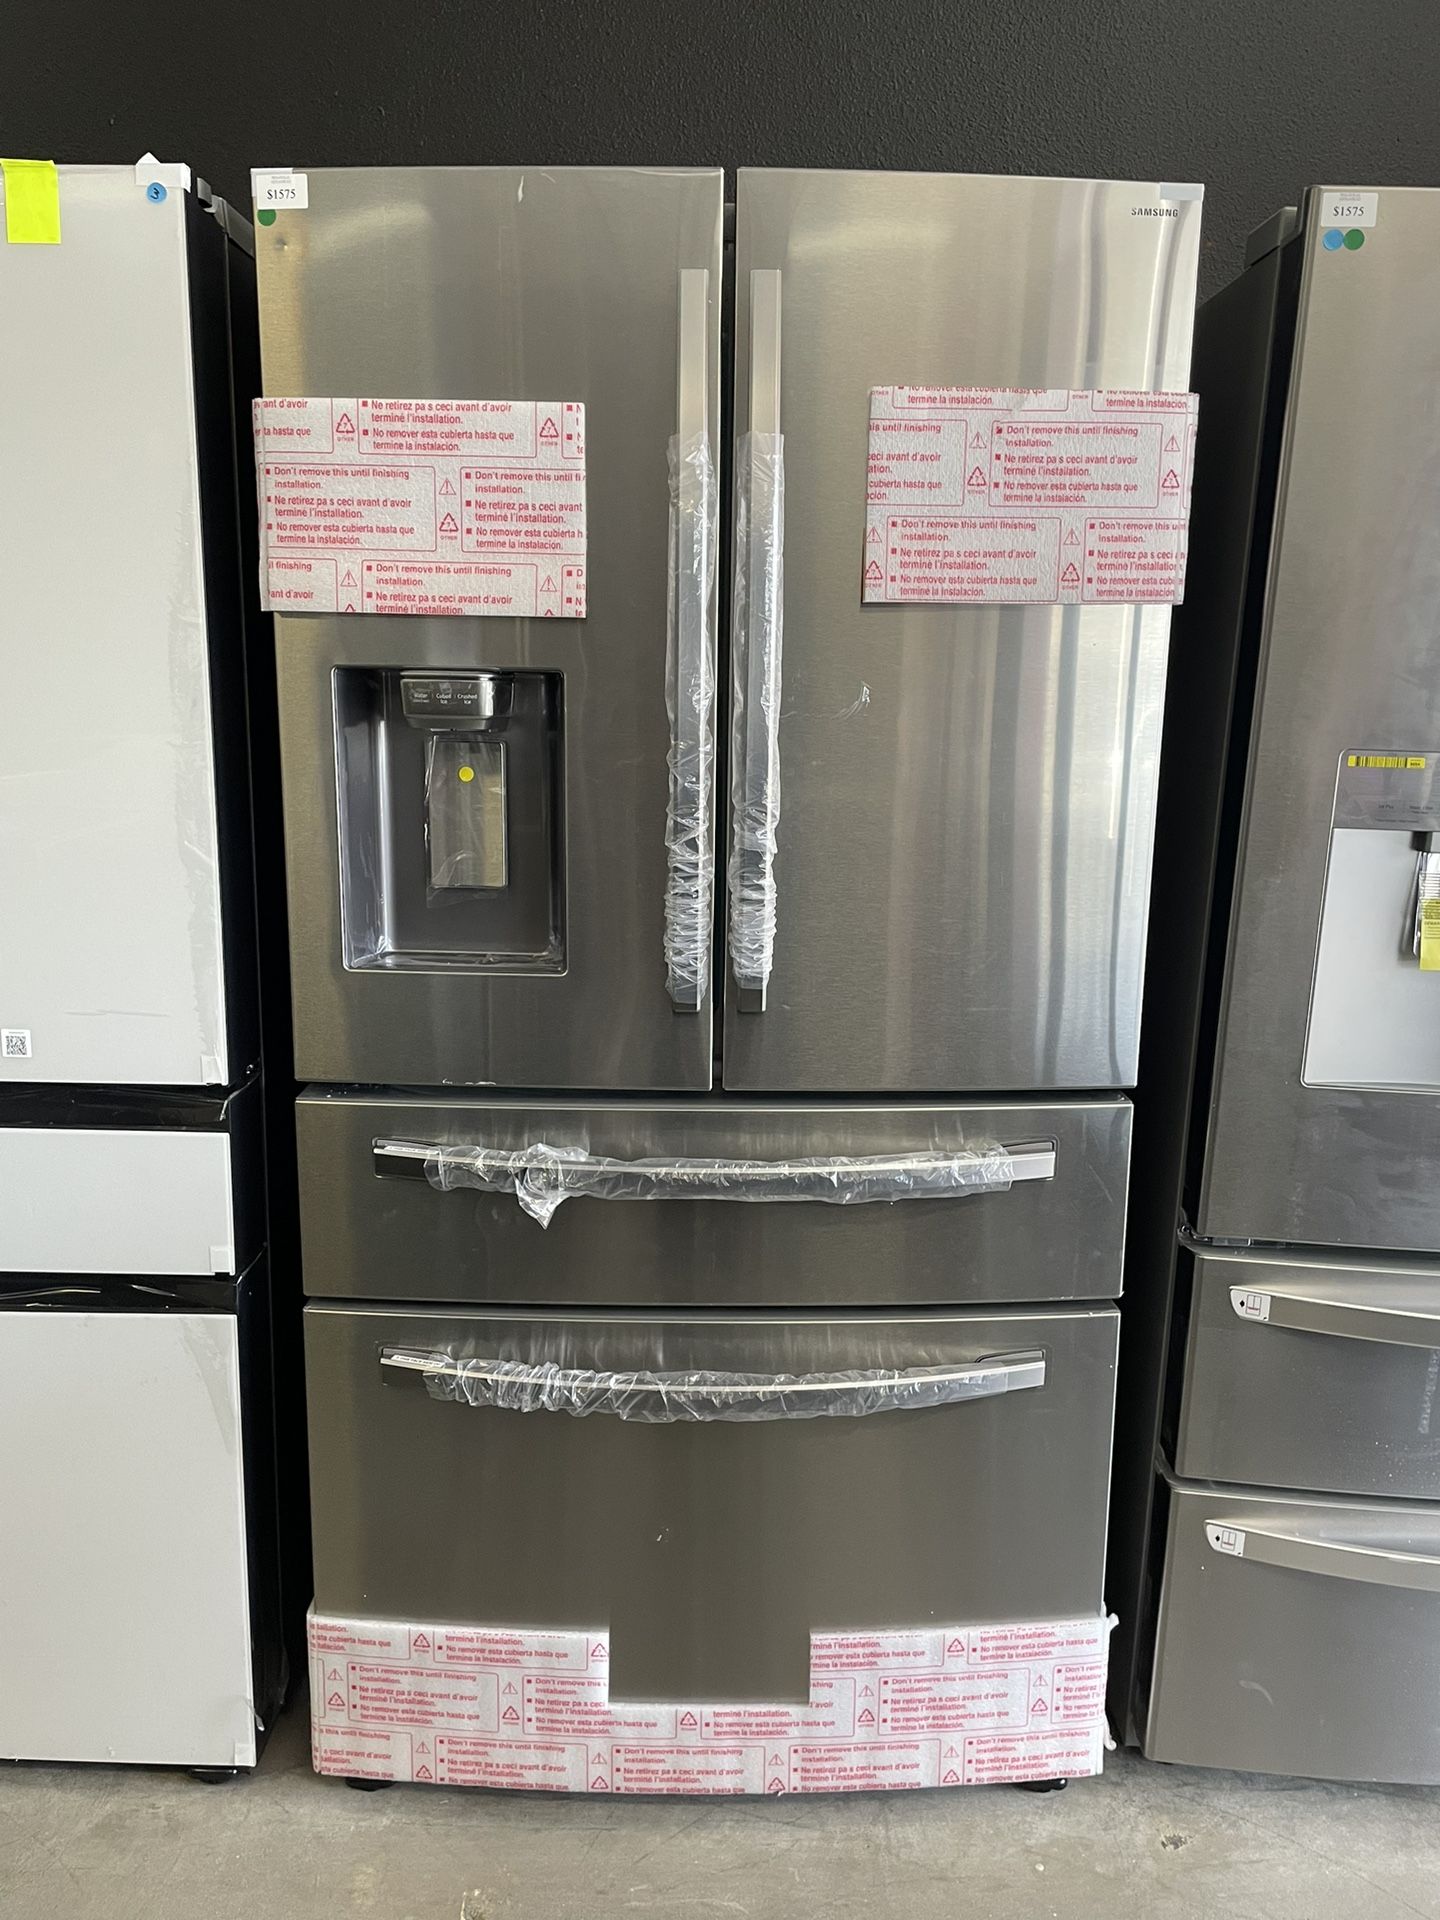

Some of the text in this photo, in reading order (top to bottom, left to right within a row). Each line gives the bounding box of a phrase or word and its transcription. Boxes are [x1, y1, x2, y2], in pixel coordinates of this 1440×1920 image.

[266, 189, 296, 200] $1575
[1131, 208, 1178, 217] SAMSUNG
[1333, 206, 1364, 216] $1575
[372, 401, 512, 414] Ne retirez pa s ceci avant d'avoir
[373, 428, 384, 437] No
[386, 430, 419, 438] remover
[440, 430, 472, 439] cubierta
[474, 431, 497, 439] hasta
[499, 432, 514, 441] que
[1007, 426, 1029, 434] Don't
[1064, 426, 1080, 434] this
[1103, 426, 1138, 437] finishing
[373, 441, 404, 450] termine
[406, 441, 413, 450] la
[1004, 454, 1016, 463] Ne
[1018, 455, 1044, 464] retirez
[1066, 455, 1082, 464] ceci
[1085, 456, 1108, 464] avant
[274, 467, 296, 475] Don't
[332, 468, 348, 476] this
[351, 469, 370, 477] until
[372, 469, 409, 480] finishing
[475, 471, 498, 479] Don't
[535, 472, 551, 481] this
[554, 473, 572, 481] until
[1004, 481, 1138, 492] No remover esta cubierta hasta que
[274, 496, 286, 504] Ne
[288, 496, 314, 505] retirez
[317, 498, 327, 507] pa
[336, 497, 354, 506] ceci
[356, 498, 380, 507] avant
[382, 498, 412, 508] d'avoir
[1004, 494, 1033, 502] termine
[1035, 494, 1042, 502] la
[475, 500, 486, 509] Ne
[489, 501, 516, 510] retirez
[518, 503, 529, 512] pa
[538, 502, 556, 511] ceci
[558, 503, 582, 512] avant
[277, 522, 414, 536] No remover esta cubierta hasta que
[926, 521, 959, 529] remove
[961, 520, 977, 529] this
[979, 521, 998, 529] until
[1000, 521, 1036, 531] finishing
[476, 527, 575, 538] No remover esta cubierta
[276, 534, 306, 543] termine
[308, 535, 315, 543] la
[476, 539, 506, 548] termine
[508, 539, 516, 548] la
[900, 548, 912, 557] Ne
[914, 549, 940, 557] retirez
[963, 550, 980, 558] ceci
[900, 574, 1037, 586] No remover esta cubierta hasta que
[900, 587, 930, 595] termine
[932, 587, 938, 595] la
